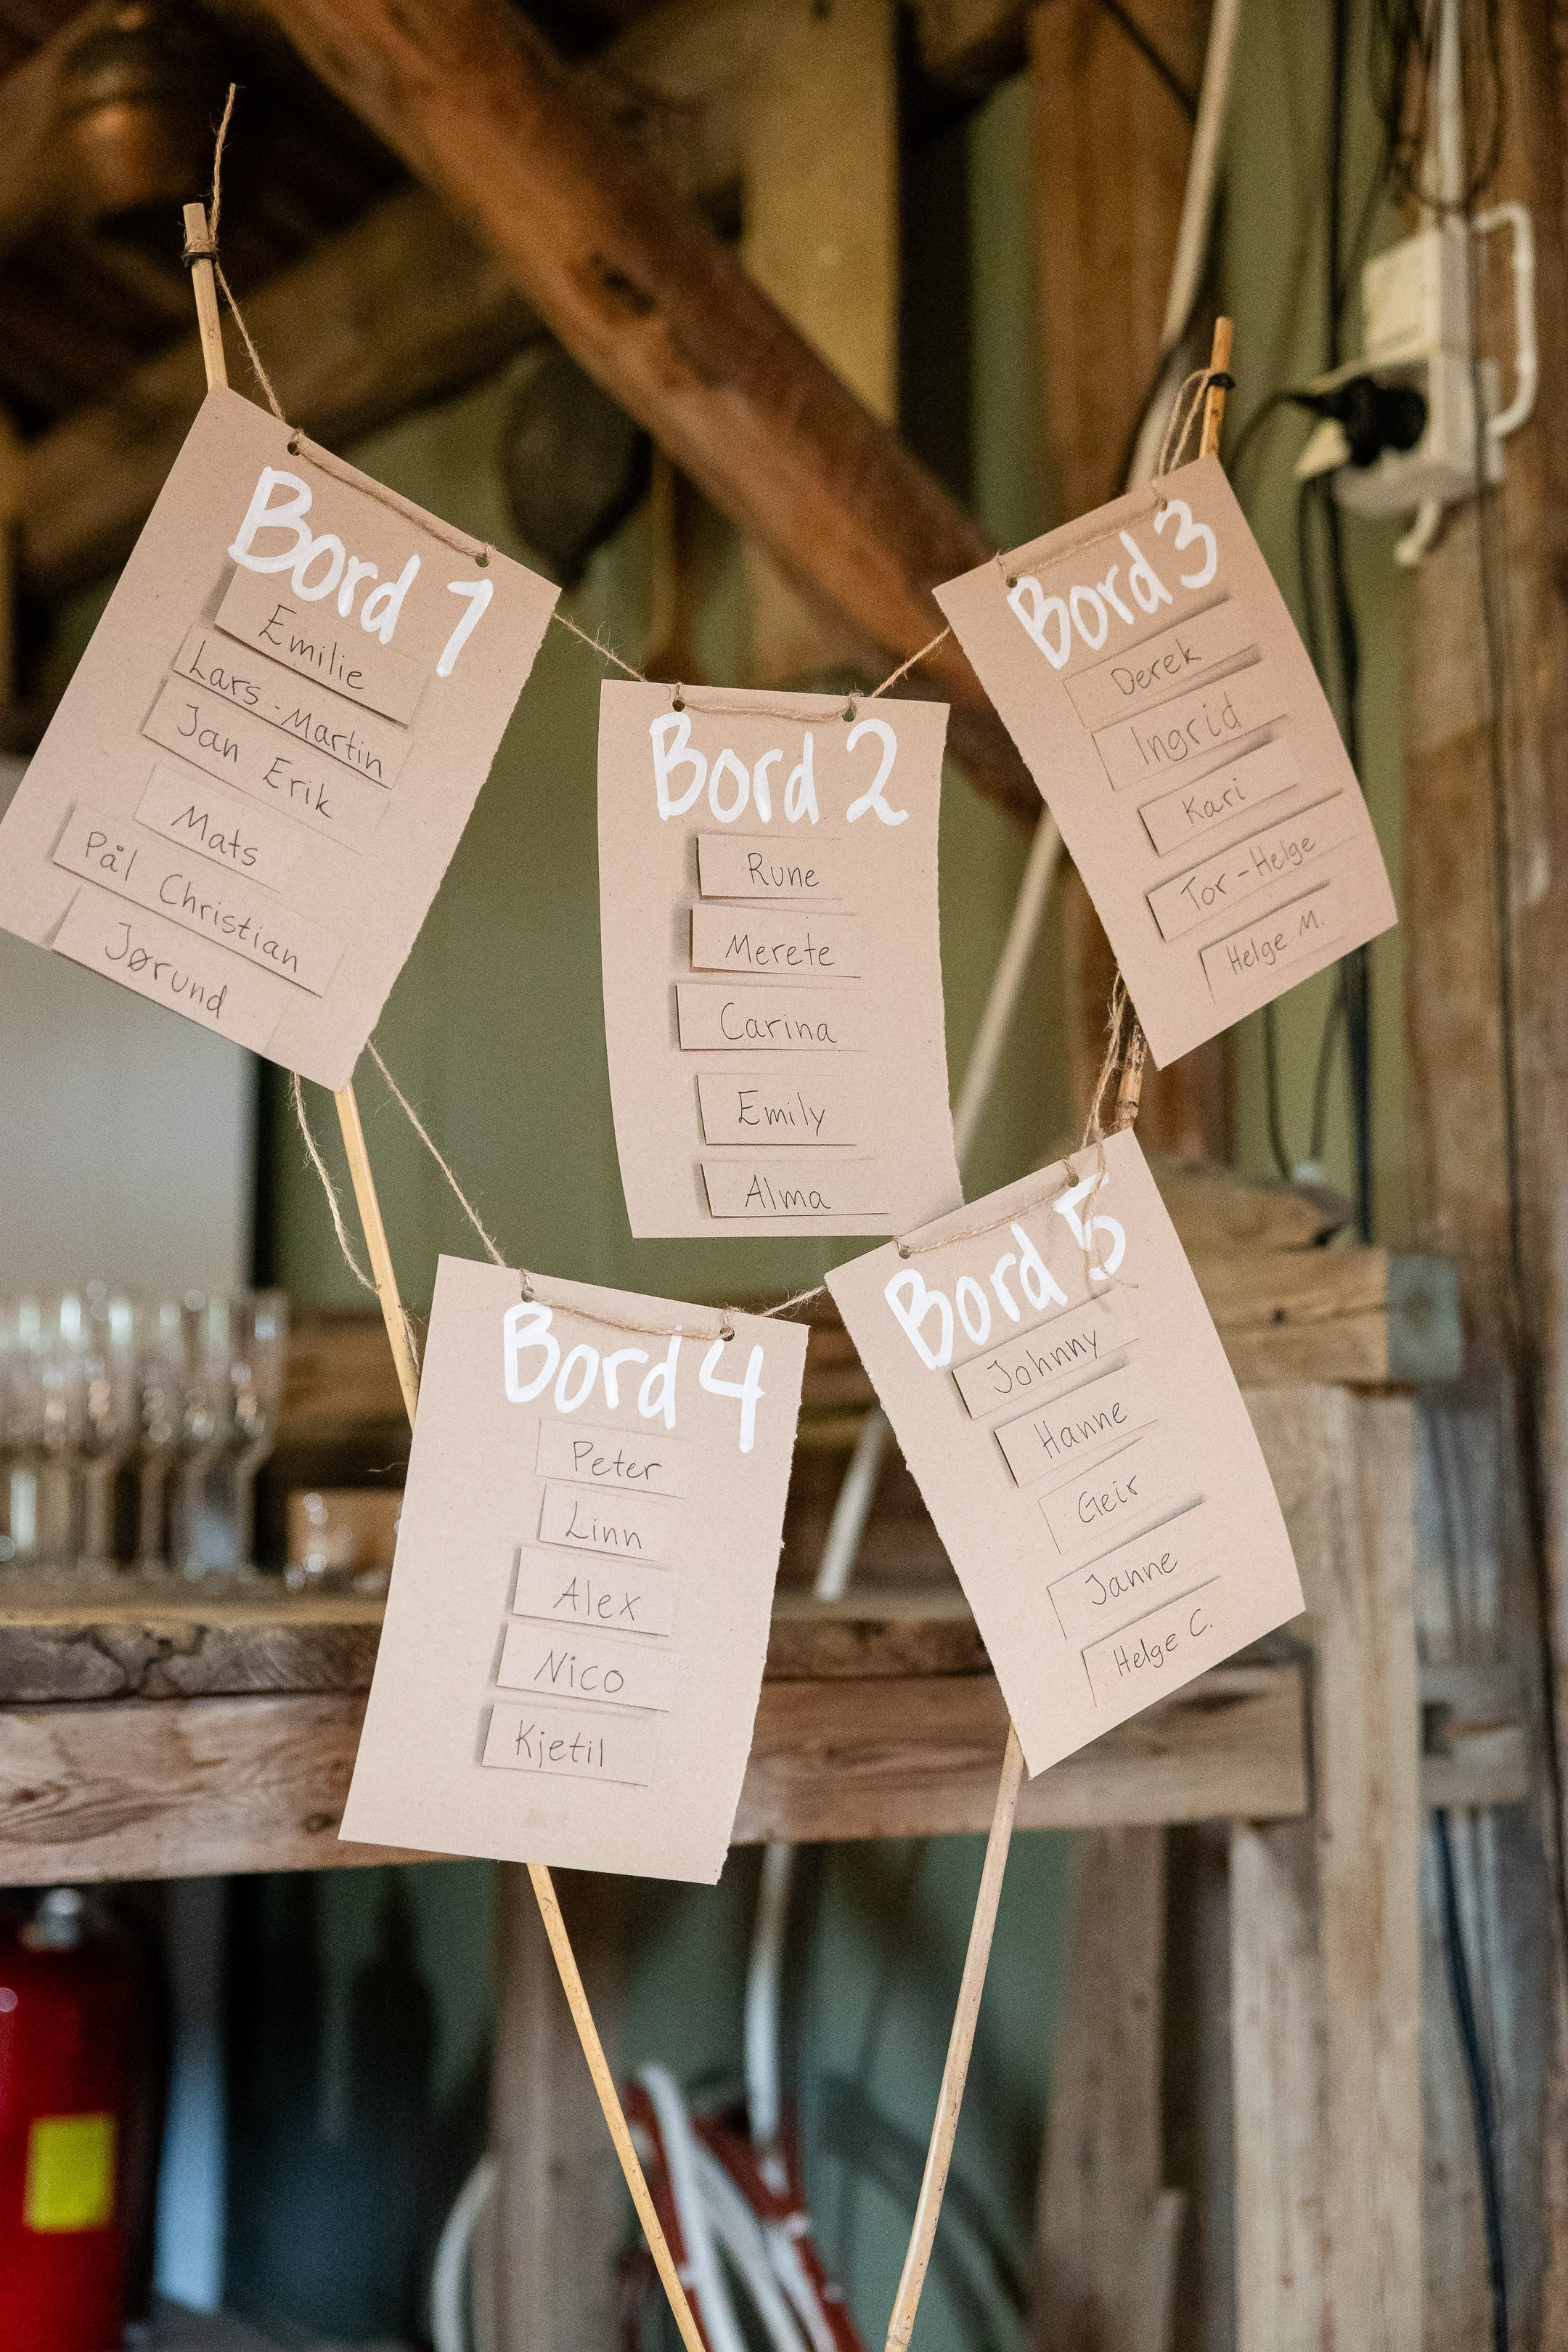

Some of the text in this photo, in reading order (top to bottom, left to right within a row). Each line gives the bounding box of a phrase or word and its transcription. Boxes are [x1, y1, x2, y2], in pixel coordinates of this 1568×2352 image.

[228, 466, 492, 677] Bord 1
[1007, 499, 1217, 670] Bord 3
[258, 604, 364, 691] Emilie
[1111, 640, 1201, 697] Derek
[1130, 691, 1243, 766] Ingrid
[178, 704, 332, 820] Jan Erik
[649, 712, 909, 826] Bord 2
[1183, 777, 1246, 825] Kari
[171, 805, 258, 867] Mats
[747, 852, 820, 888] Rune
[1180, 833, 1316, 912] Tor-Helge
[85, 831, 299, 973] Pål Christian
[105, 922, 228, 1019] Jørund
[726, 932, 836, 966] Merete
[1227, 928, 1288, 976] Helge
[721, 1002, 837, 1044] Carina
[737, 1090, 825, 1135] Emily
[745, 1174, 831, 1210] Alma
[884, 1172, 1126, 1371] Bord 5
[503, 1301, 764, 1453] Bord 4
[993, 1328, 1099, 1395] Johnny
[1034, 1399, 1128, 1457] Hanne
[572, 1441, 661, 1480] Peter
[565, 1501, 643, 1551] Linn
[1077, 1474, 1139, 1524] Geir
[553, 1577, 641, 1621] Alex
[1086, 1549, 1178, 1605] Janne
[1114, 1607, 1214, 1676] Helge C.
[534, 1649, 624, 1694] Nico
[515, 1720, 604, 1768] Kjetil
